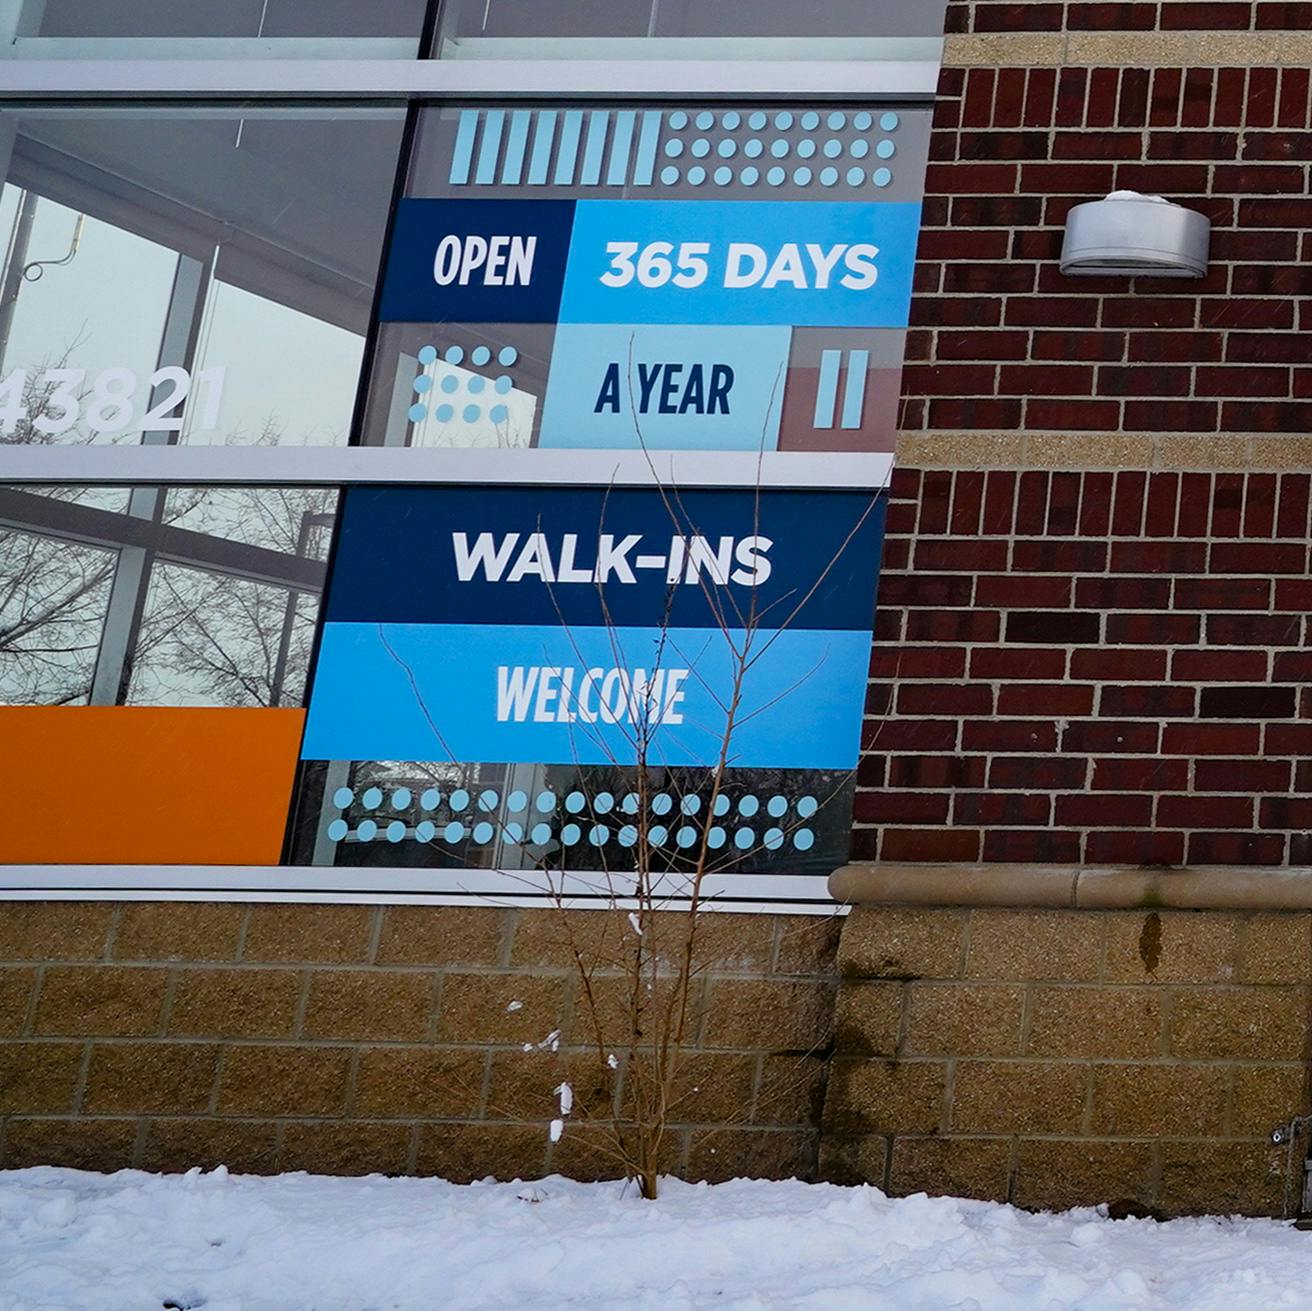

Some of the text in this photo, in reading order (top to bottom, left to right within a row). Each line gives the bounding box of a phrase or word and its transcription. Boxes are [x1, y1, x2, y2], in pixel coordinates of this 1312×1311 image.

[432, 233, 538, 288] OPEN
[599, 241, 881, 291] 365 DAYS
[0, 364, 229, 434] 43821
[593, 362, 736, 416] A YEAR
[450, 530, 775, 587] WALK-INS
[495, 665, 691, 725] WELCOME
